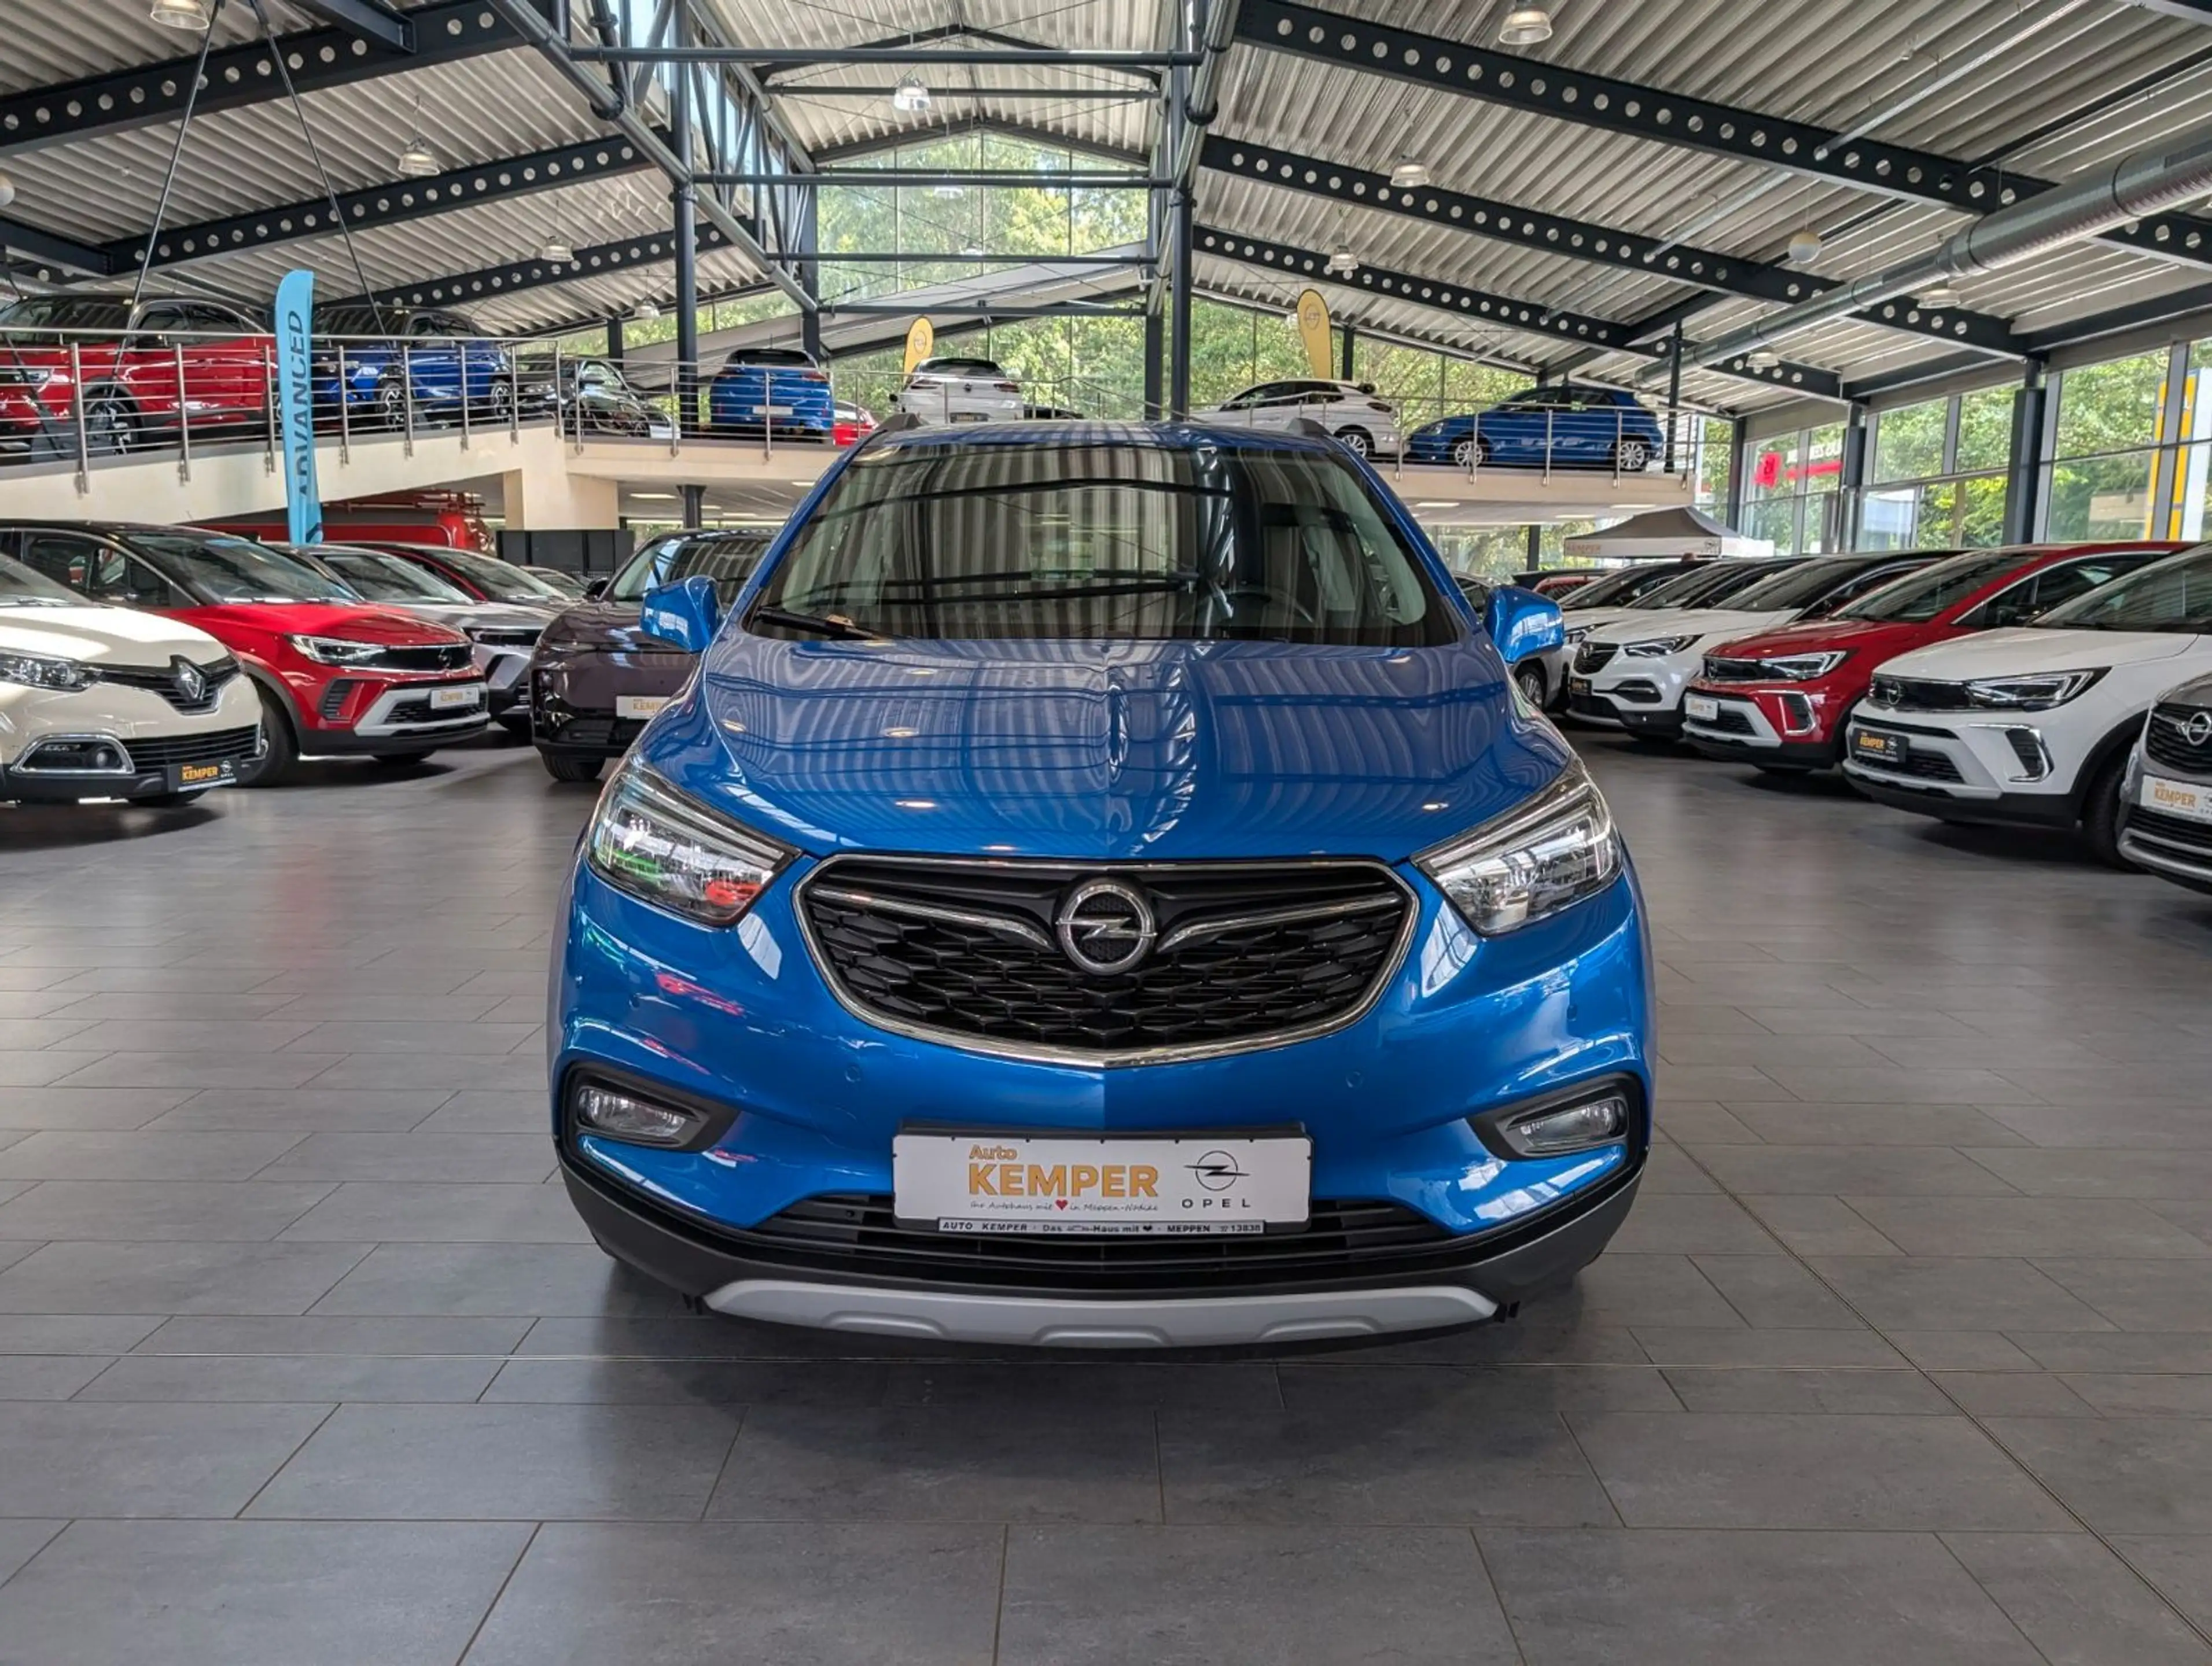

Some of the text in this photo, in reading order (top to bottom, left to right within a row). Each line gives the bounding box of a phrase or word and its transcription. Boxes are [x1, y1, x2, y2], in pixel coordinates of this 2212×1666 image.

[2155, 787, 2196, 808] KEMPER
[969, 1145, 1018, 1160] Auto
[969, 1163, 1159, 1197] KEMPER
[988, 1201, 1033, 1211] Autohaus
[1036, 1202, 1052, 1210] mit
[1070, 1203, 1080, 1211] in
[1182, 1199, 1251, 1209] OPEL
[943, 1222, 973, 1230] AUTO
[982, 1223, 1028, 1231] KEMPER
[1043, 1224, 1062, 1232] Das
[1122, 1224, 1140, 1232] mit
